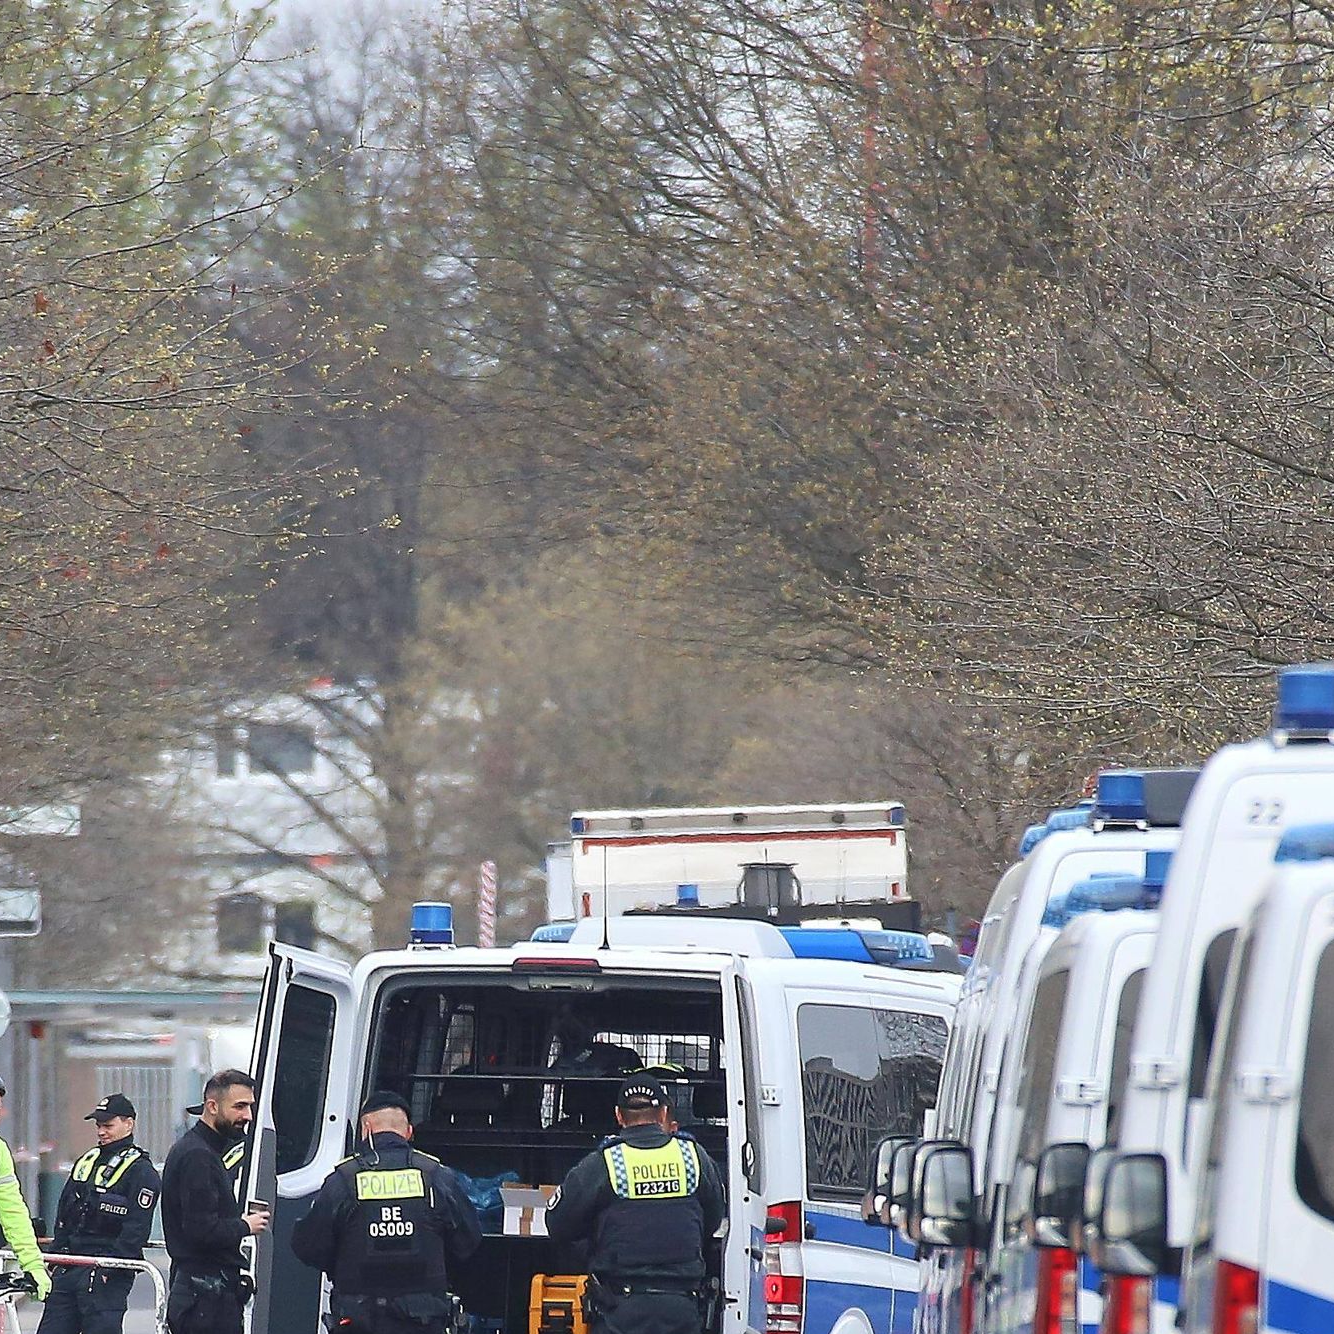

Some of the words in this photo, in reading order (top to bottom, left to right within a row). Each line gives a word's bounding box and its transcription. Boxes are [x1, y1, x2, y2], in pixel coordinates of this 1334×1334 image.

[632, 1162, 680, 1180] POLIZEI
[360, 1172, 422, 1196] POLIZEI
[635, 1180, 680, 1195] 123216
[100, 1202, 128, 1216] POLIZEI
[381, 1206, 402, 1221] BE
